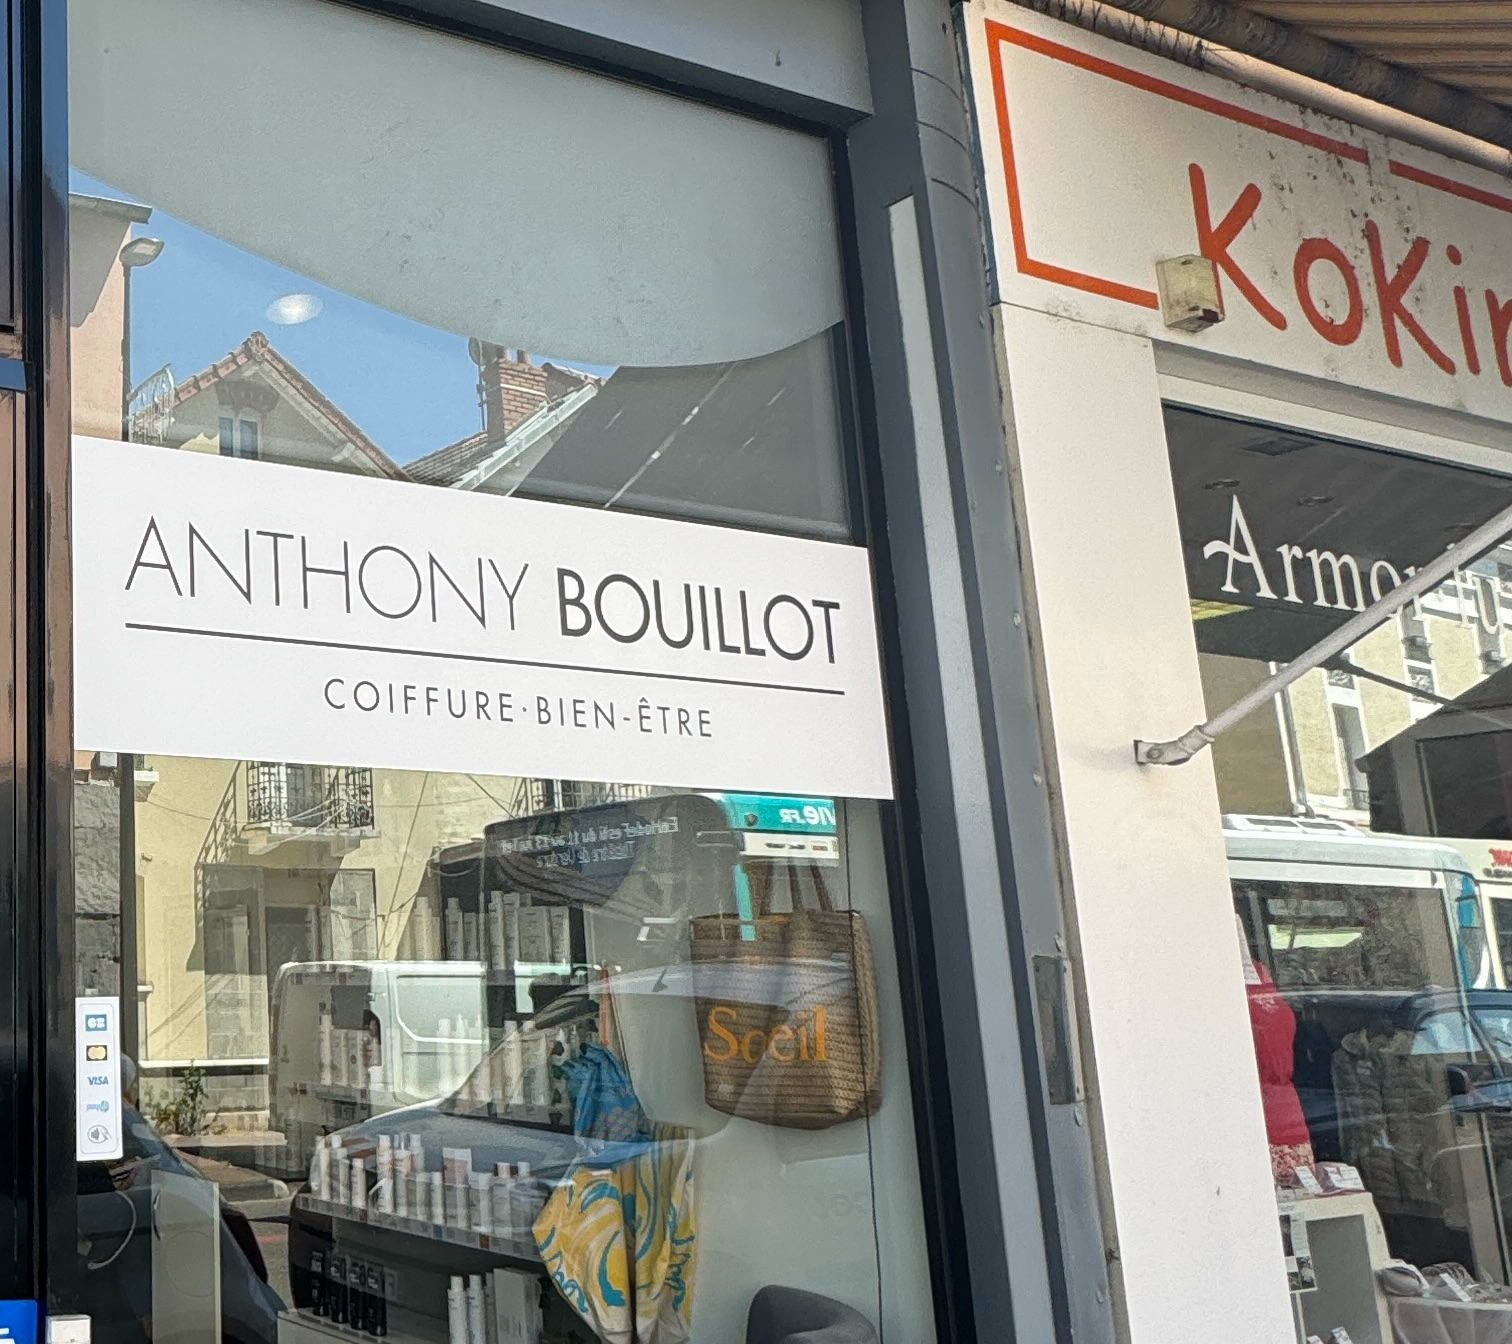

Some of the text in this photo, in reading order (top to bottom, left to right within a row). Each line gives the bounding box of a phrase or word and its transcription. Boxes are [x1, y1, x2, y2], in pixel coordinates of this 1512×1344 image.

[124, 514, 841, 665] ANTHONY BOUILLOT
[87, 1076, 109, 1086] VISA
